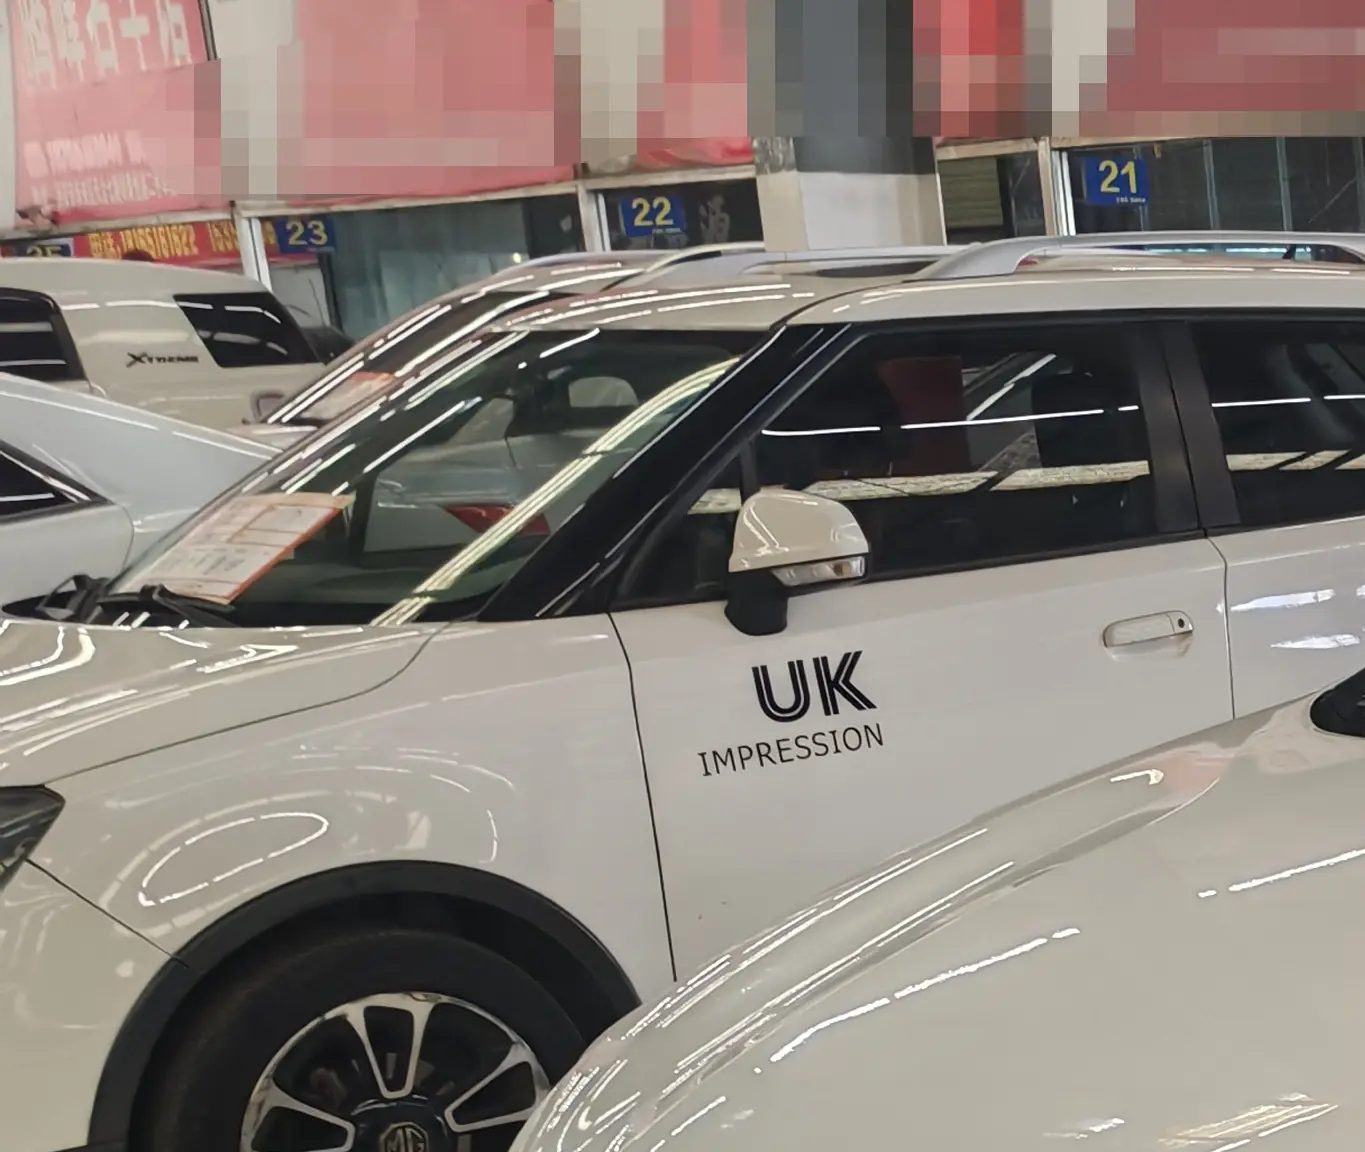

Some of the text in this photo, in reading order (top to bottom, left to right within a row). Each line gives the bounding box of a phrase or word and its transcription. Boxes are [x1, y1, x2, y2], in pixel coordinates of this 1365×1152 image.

[1098, 159, 1138, 194] 21
[631, 196, 674, 227] 22
[285, 220, 328, 246] 23
[751, 649, 877, 723] UK
[697, 722, 884, 776] IMPRESSION
